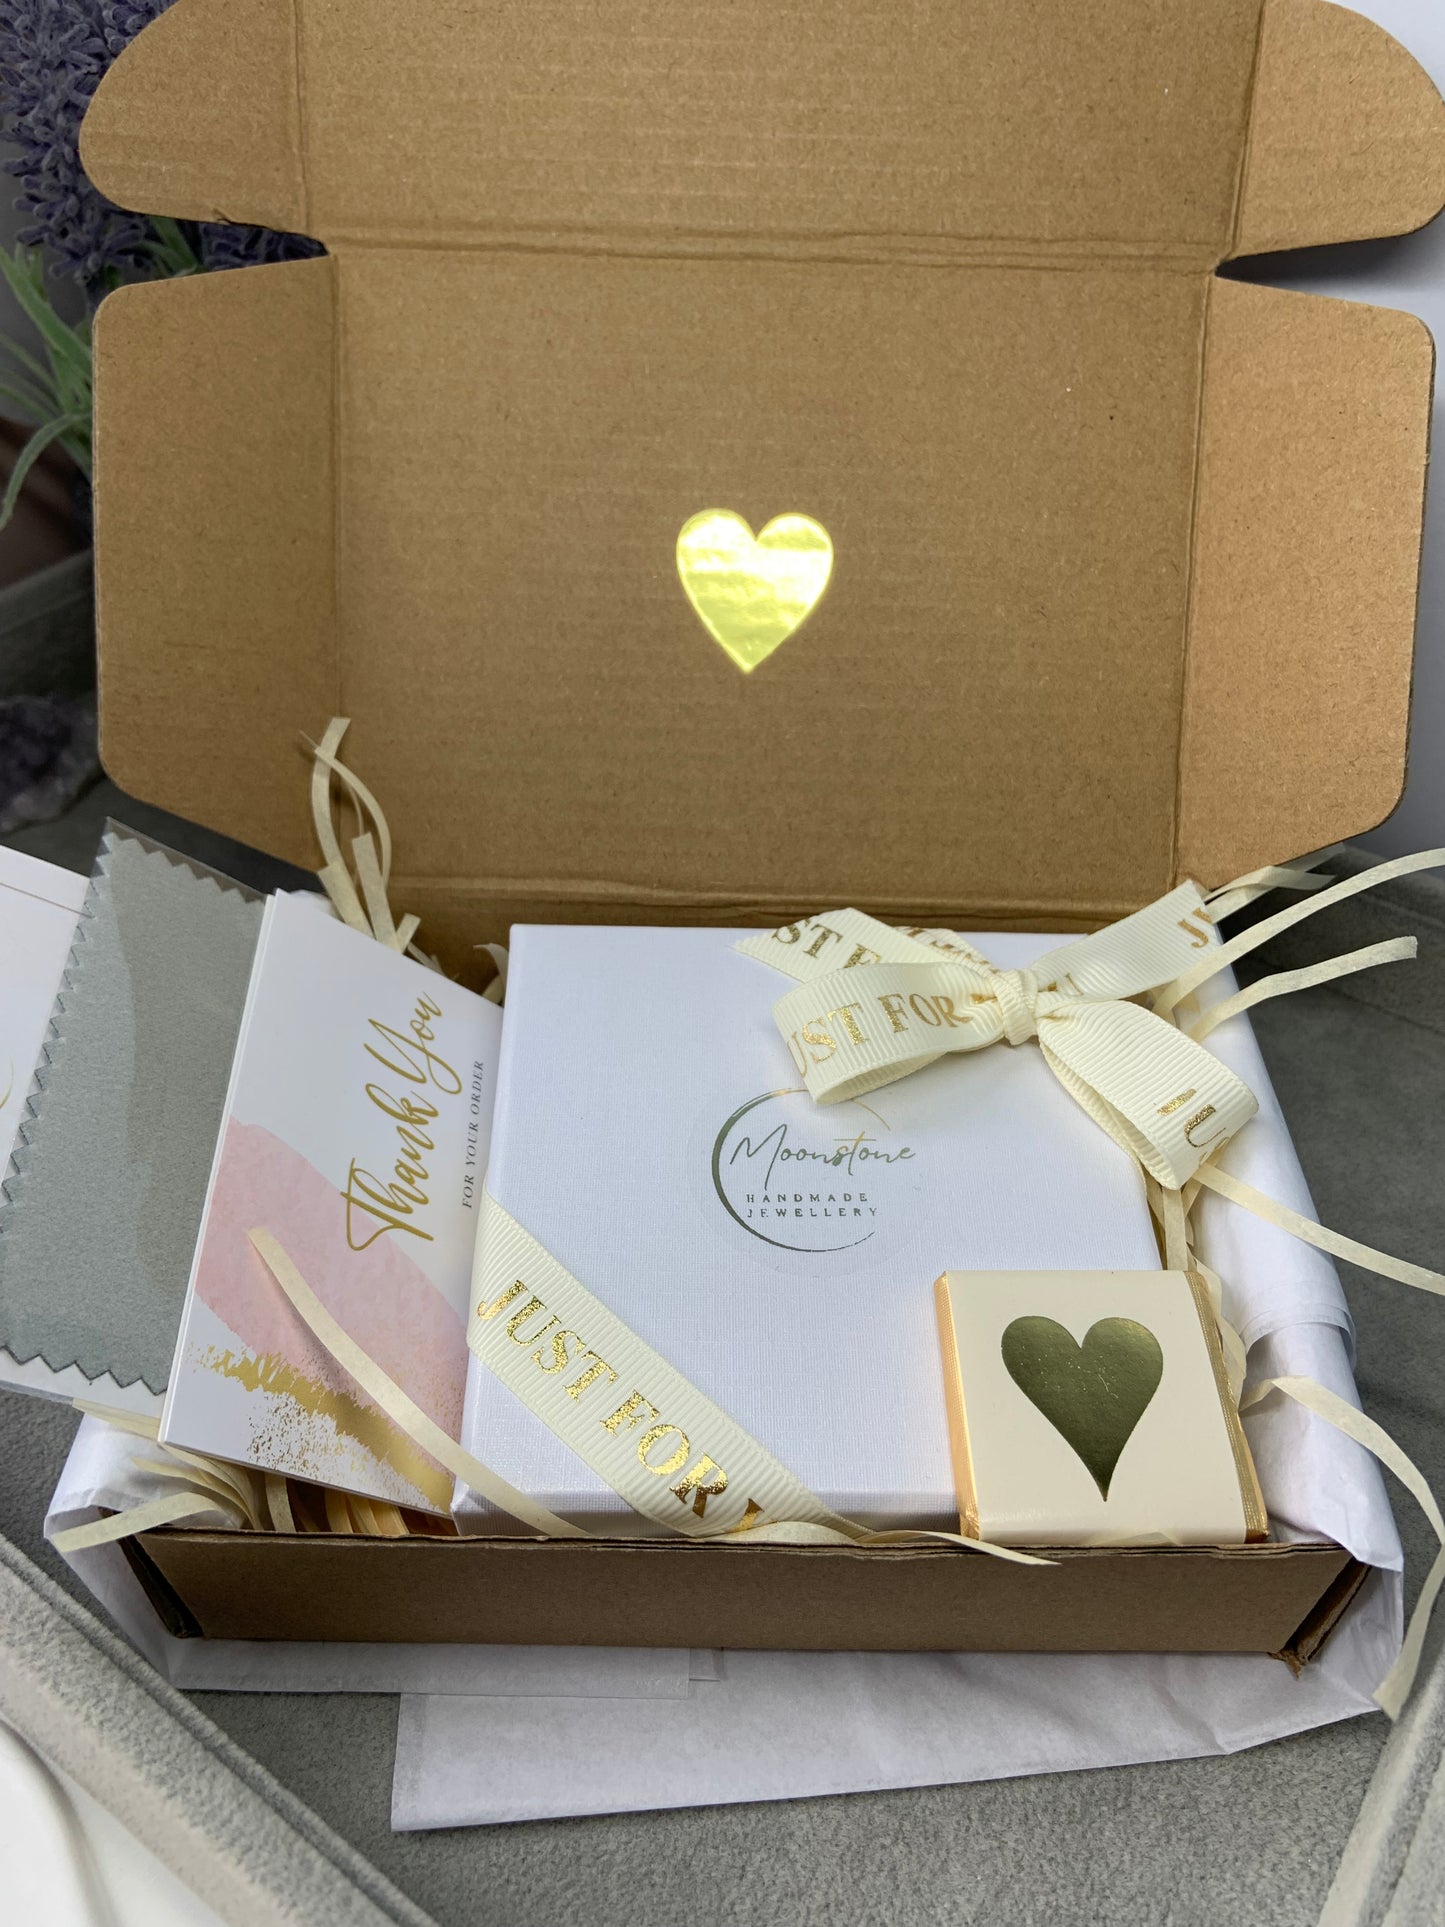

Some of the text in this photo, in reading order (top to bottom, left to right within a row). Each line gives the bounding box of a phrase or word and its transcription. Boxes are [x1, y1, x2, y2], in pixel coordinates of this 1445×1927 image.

[877, 993, 974, 1035] FOR
[340, 991, 463, 1251] Thank You
[462, 1060, 484, 1210] FOR YOUR ORDER
[729, 1123, 917, 1191] Moonstone
[746, 1193, 868, 1204] HANDMADE
[747, 1207, 878, 1218] JEWELLERY
[477, 1279, 729, 1519] JUST FOR
